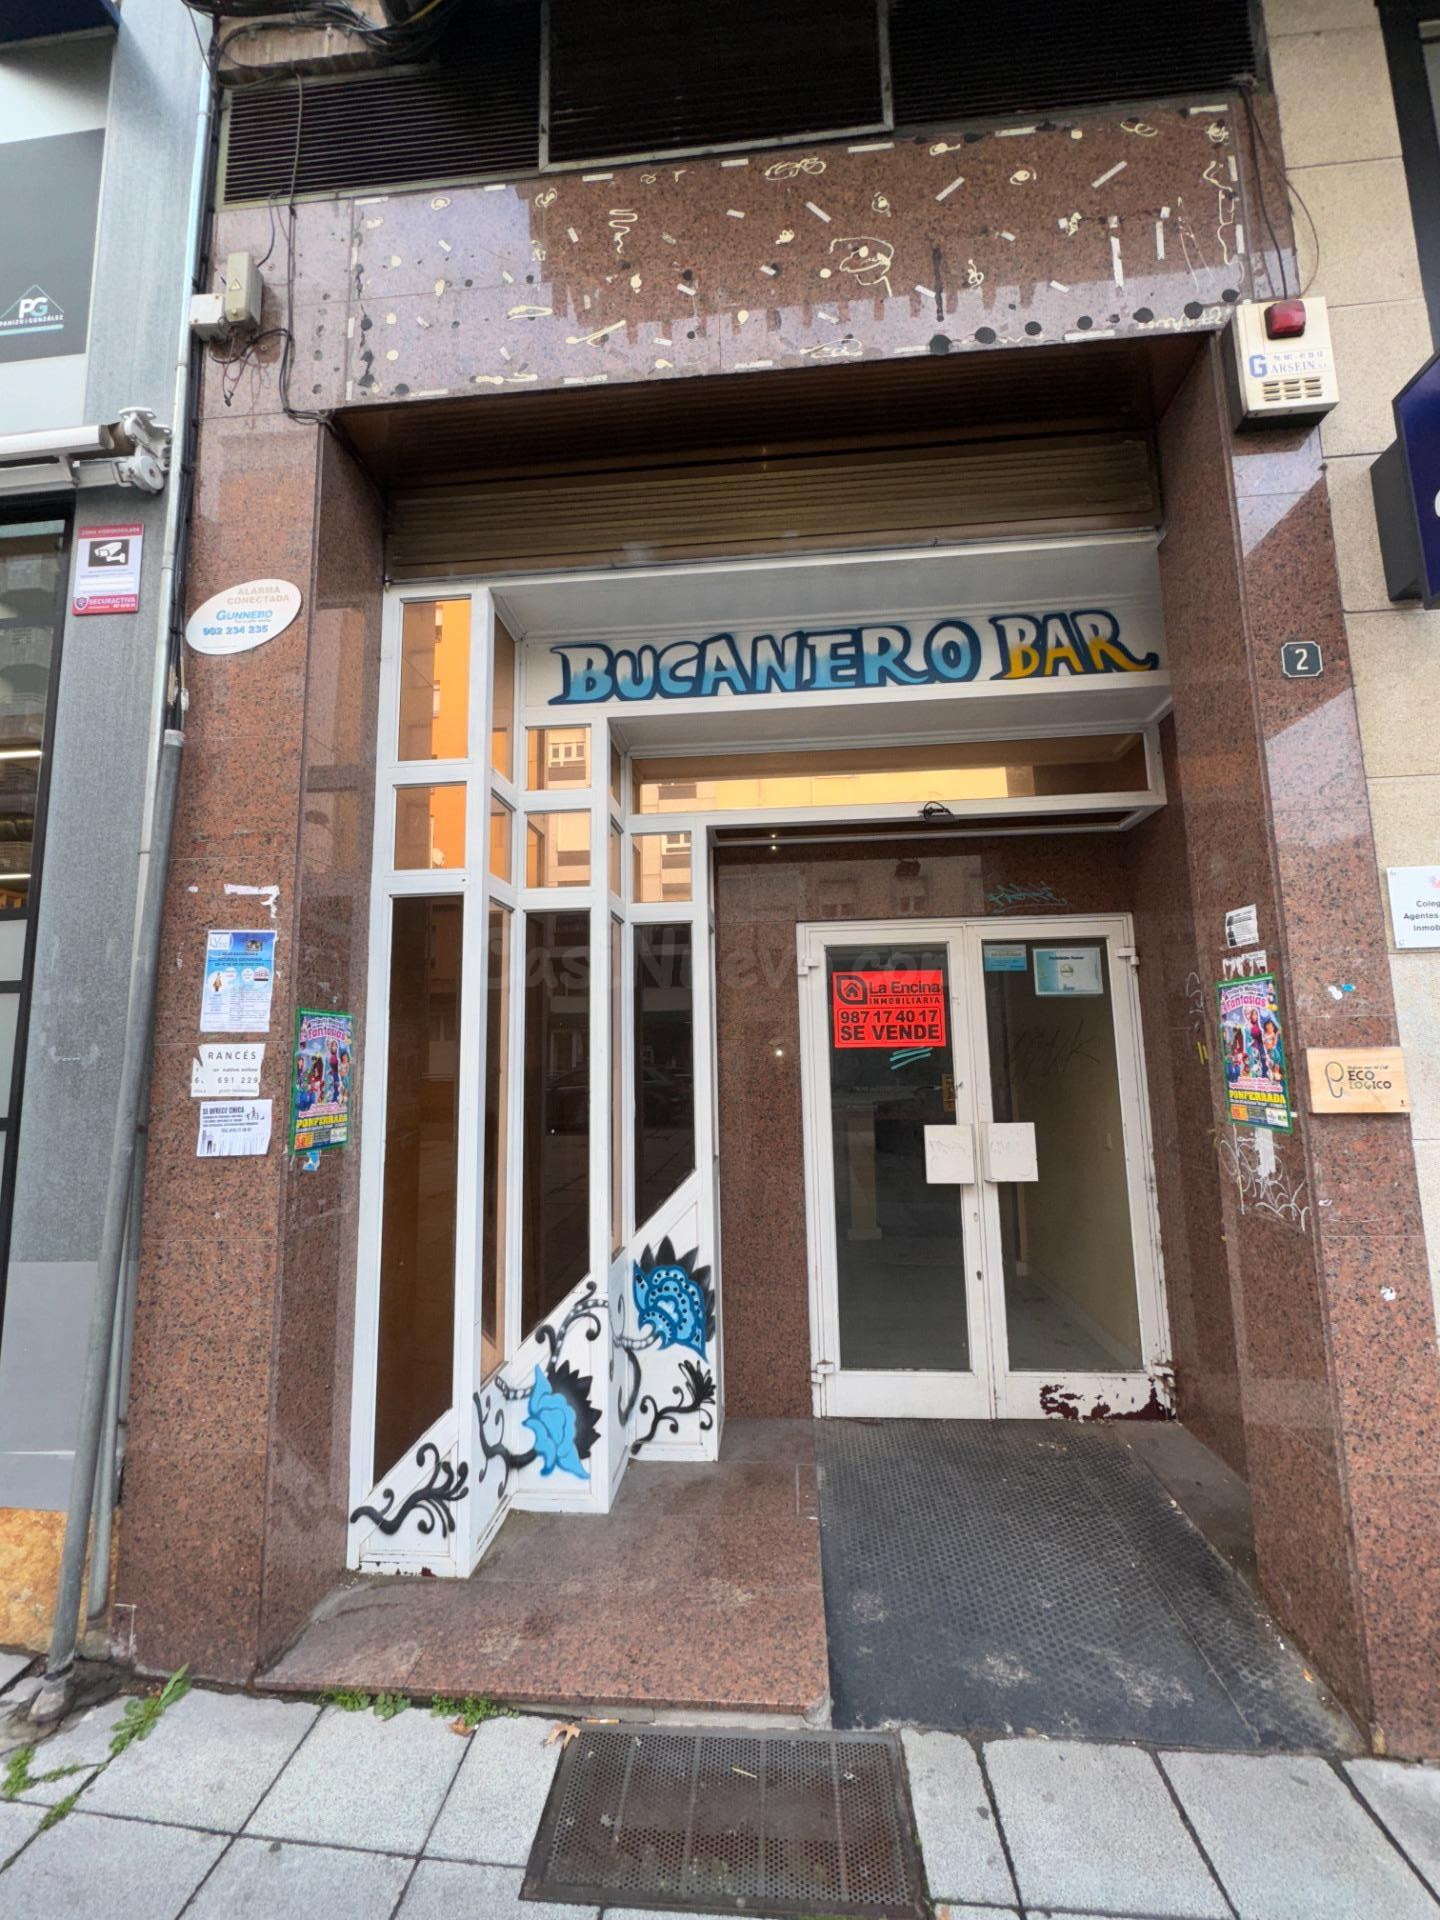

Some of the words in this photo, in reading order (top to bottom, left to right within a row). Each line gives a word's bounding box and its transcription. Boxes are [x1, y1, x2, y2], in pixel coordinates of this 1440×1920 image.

[18, 297, 49, 319] PG
[238, 586, 280, 596] ALARMA
[227, 595, 290, 605] CONECTADA
[203, 627, 223, 636] 902
[226, 626, 246, 635] 234
[248, 624, 269, 634] 235
[549, 618, 983, 706] BUCANERO
[988, 609, 1160, 682] BAR
[1294, 648, 1309, 671] 2
[1404, 912, 1439, 921] Agentes
[869, 982, 887, 994] La
[891, 981, 940, 994] Encina
[869, 997, 940, 1005] INMOBILIARIA
[840, 1010, 869, 1024] 987
[873, 1010, 892, 1023] 17
[896, 1010, 915, 1023] 40
[919, 1009, 938, 1022] 17
[840, 1025, 865, 1041] SE
[871, 1024, 940, 1040] VENDE
[1347, 1070, 1375, 1081] ECO
